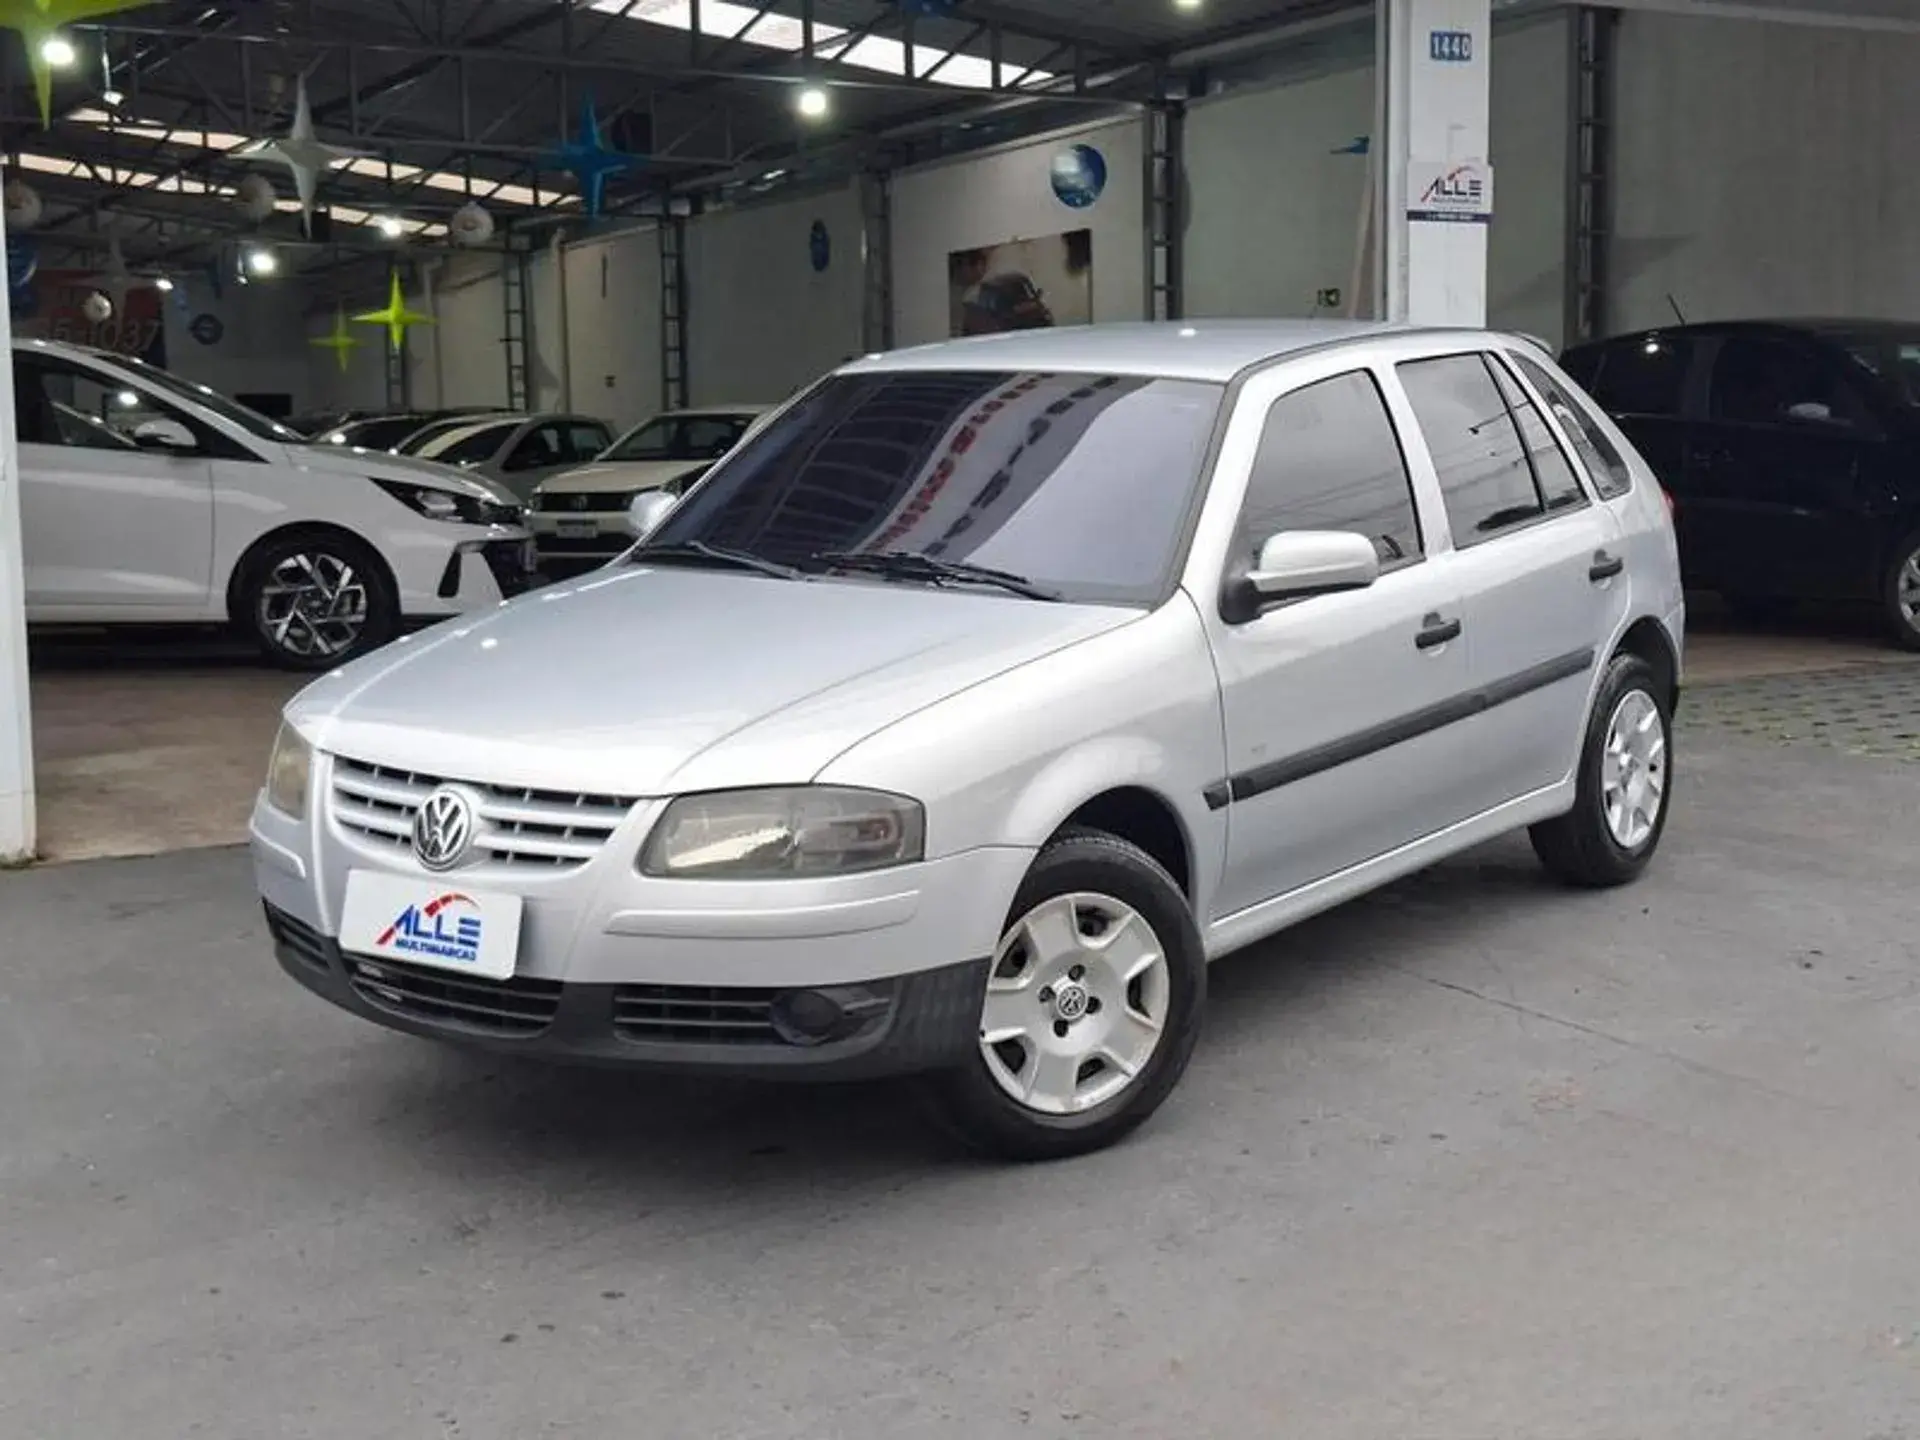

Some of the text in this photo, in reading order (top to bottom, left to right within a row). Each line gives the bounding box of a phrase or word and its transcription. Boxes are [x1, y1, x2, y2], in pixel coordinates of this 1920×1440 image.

[1433, 35, 1472, 58] 1440
[1421, 177, 1482, 202] ALLE
[376, 903, 482, 949] ALLE
